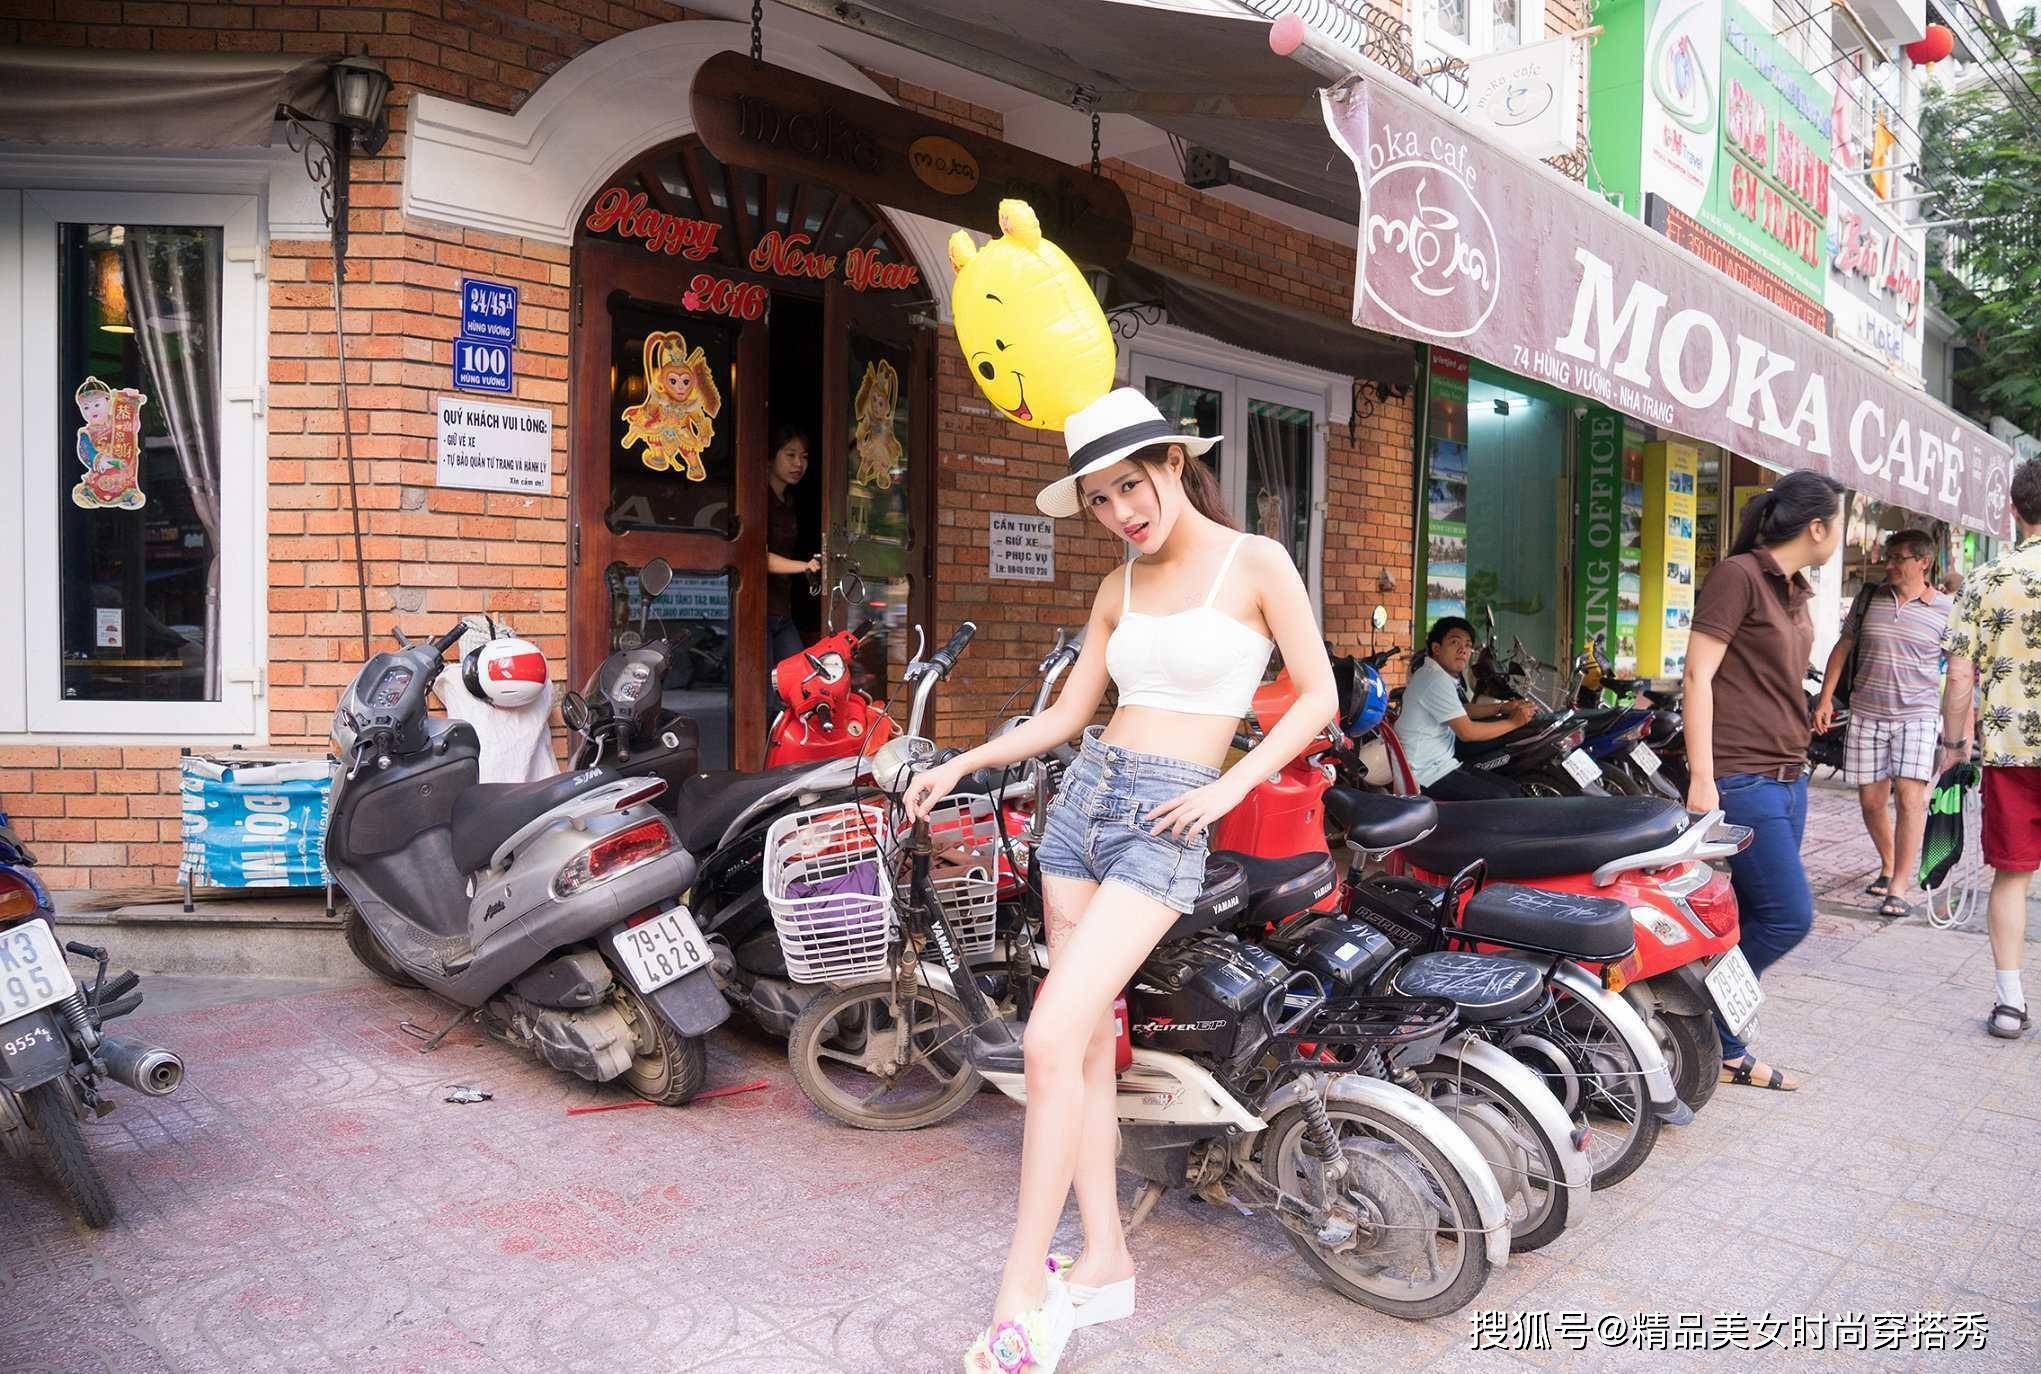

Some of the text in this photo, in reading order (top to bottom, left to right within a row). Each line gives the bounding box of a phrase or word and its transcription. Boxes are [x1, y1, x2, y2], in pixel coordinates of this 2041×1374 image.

[1430, 135, 1478, 190] cafe
[586, 187, 920, 292] Happy New Year
[690, 273, 768, 321] 2016
[461, 345, 506, 375] 100
[1556, 247, 1831, 457] MOKA
[1848, 399, 1964, 507] CAFÉ
[1513, 344, 1530, 368] 74
[1533, 348, 1570, 384] HÙNG
[1620, 386, 1640, 412] NHA
[1642, 395, 1674, 424] TRANG
[443, 407, 463, 426] QUÝ
[466, 410, 500, 429] KHÁCH
[502, 415, 518, 431] VUI
[468, 436, 476, 448] XE
[496, 458, 514, 471] TRANG
[509, 477, 519, 485] Xin
[1587, 415, 1614, 550] OFFICE
[1025, 538, 1039, 547] XE
[233, 794, 298, 844] ĐỘI
[1212, 895, 1240, 916] YAMAHA
[1312, 881, 1333, 900] YAMAHA
[627, 914, 686, 959] 79-L1
[930, 920, 960, 974] YAMAHA
[642, 939, 701, 985] 4828
[0, 966, 54, 1018] 95
[4, 1032, 36, 1056] 955
